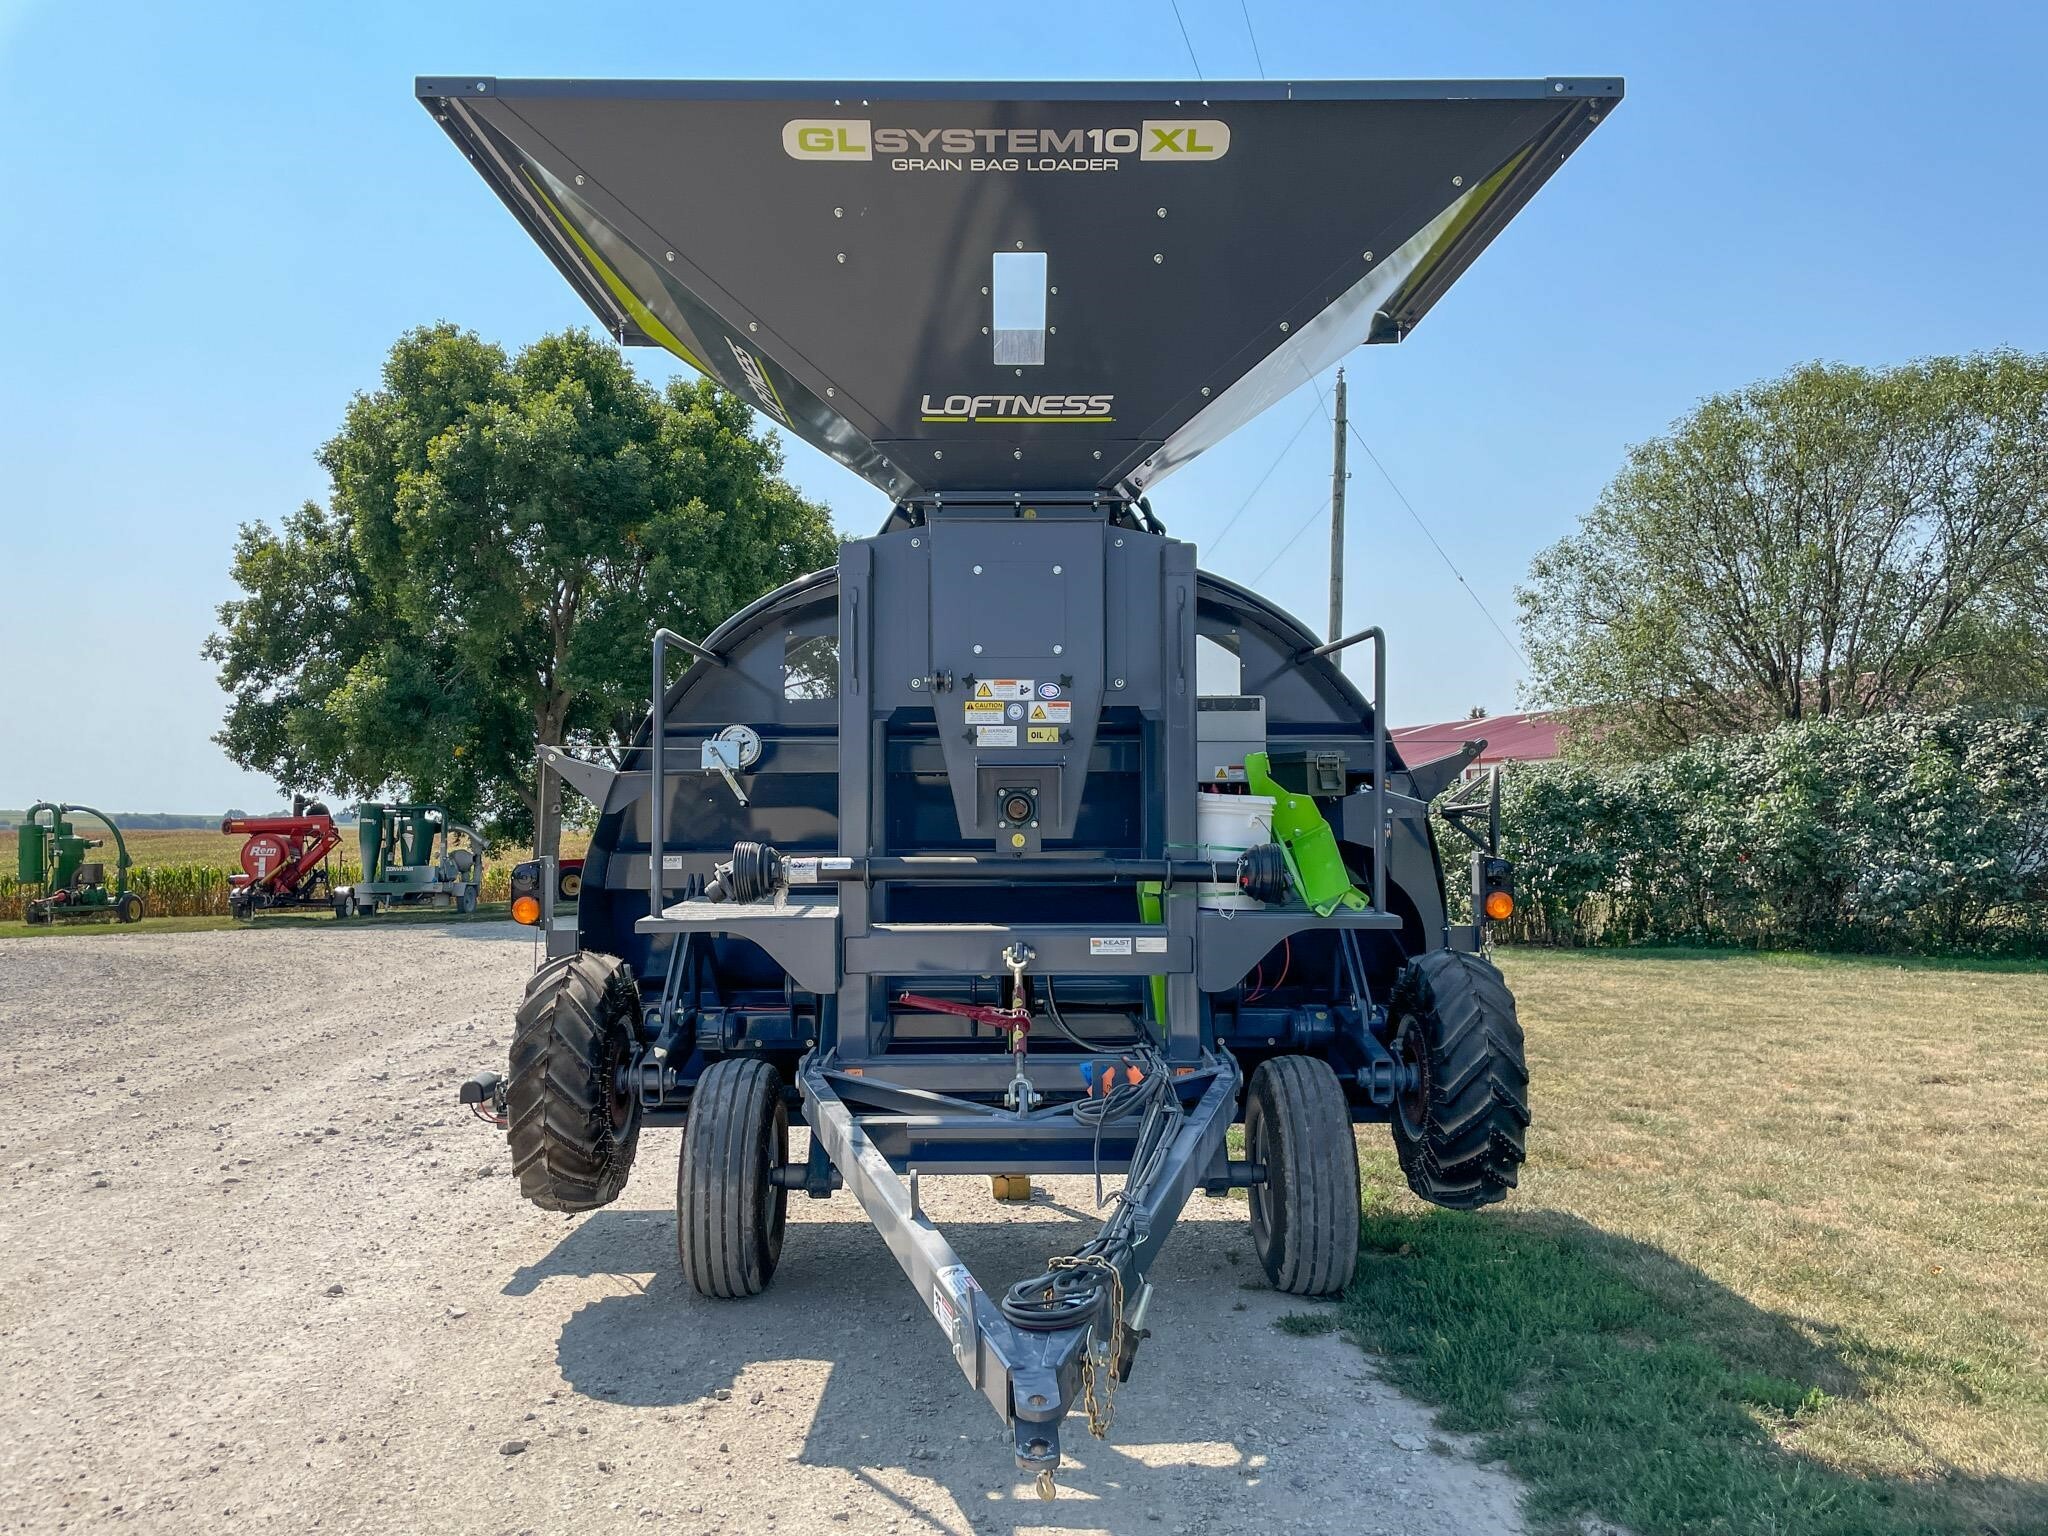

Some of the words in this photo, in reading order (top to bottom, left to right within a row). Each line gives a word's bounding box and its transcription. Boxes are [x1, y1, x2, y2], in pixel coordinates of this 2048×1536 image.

[799, 127, 867, 152] GL
[1147, 128, 1215, 152] XL
[891, 158, 962, 171] GRAIN
[970, 158, 1019, 171] BAG
[1027, 158, 1119, 171] LOADER
[921, 394, 1114, 417] LOFTNESS
[1031, 731, 1043, 739] OIL
[250, 846, 277, 856] Rem
